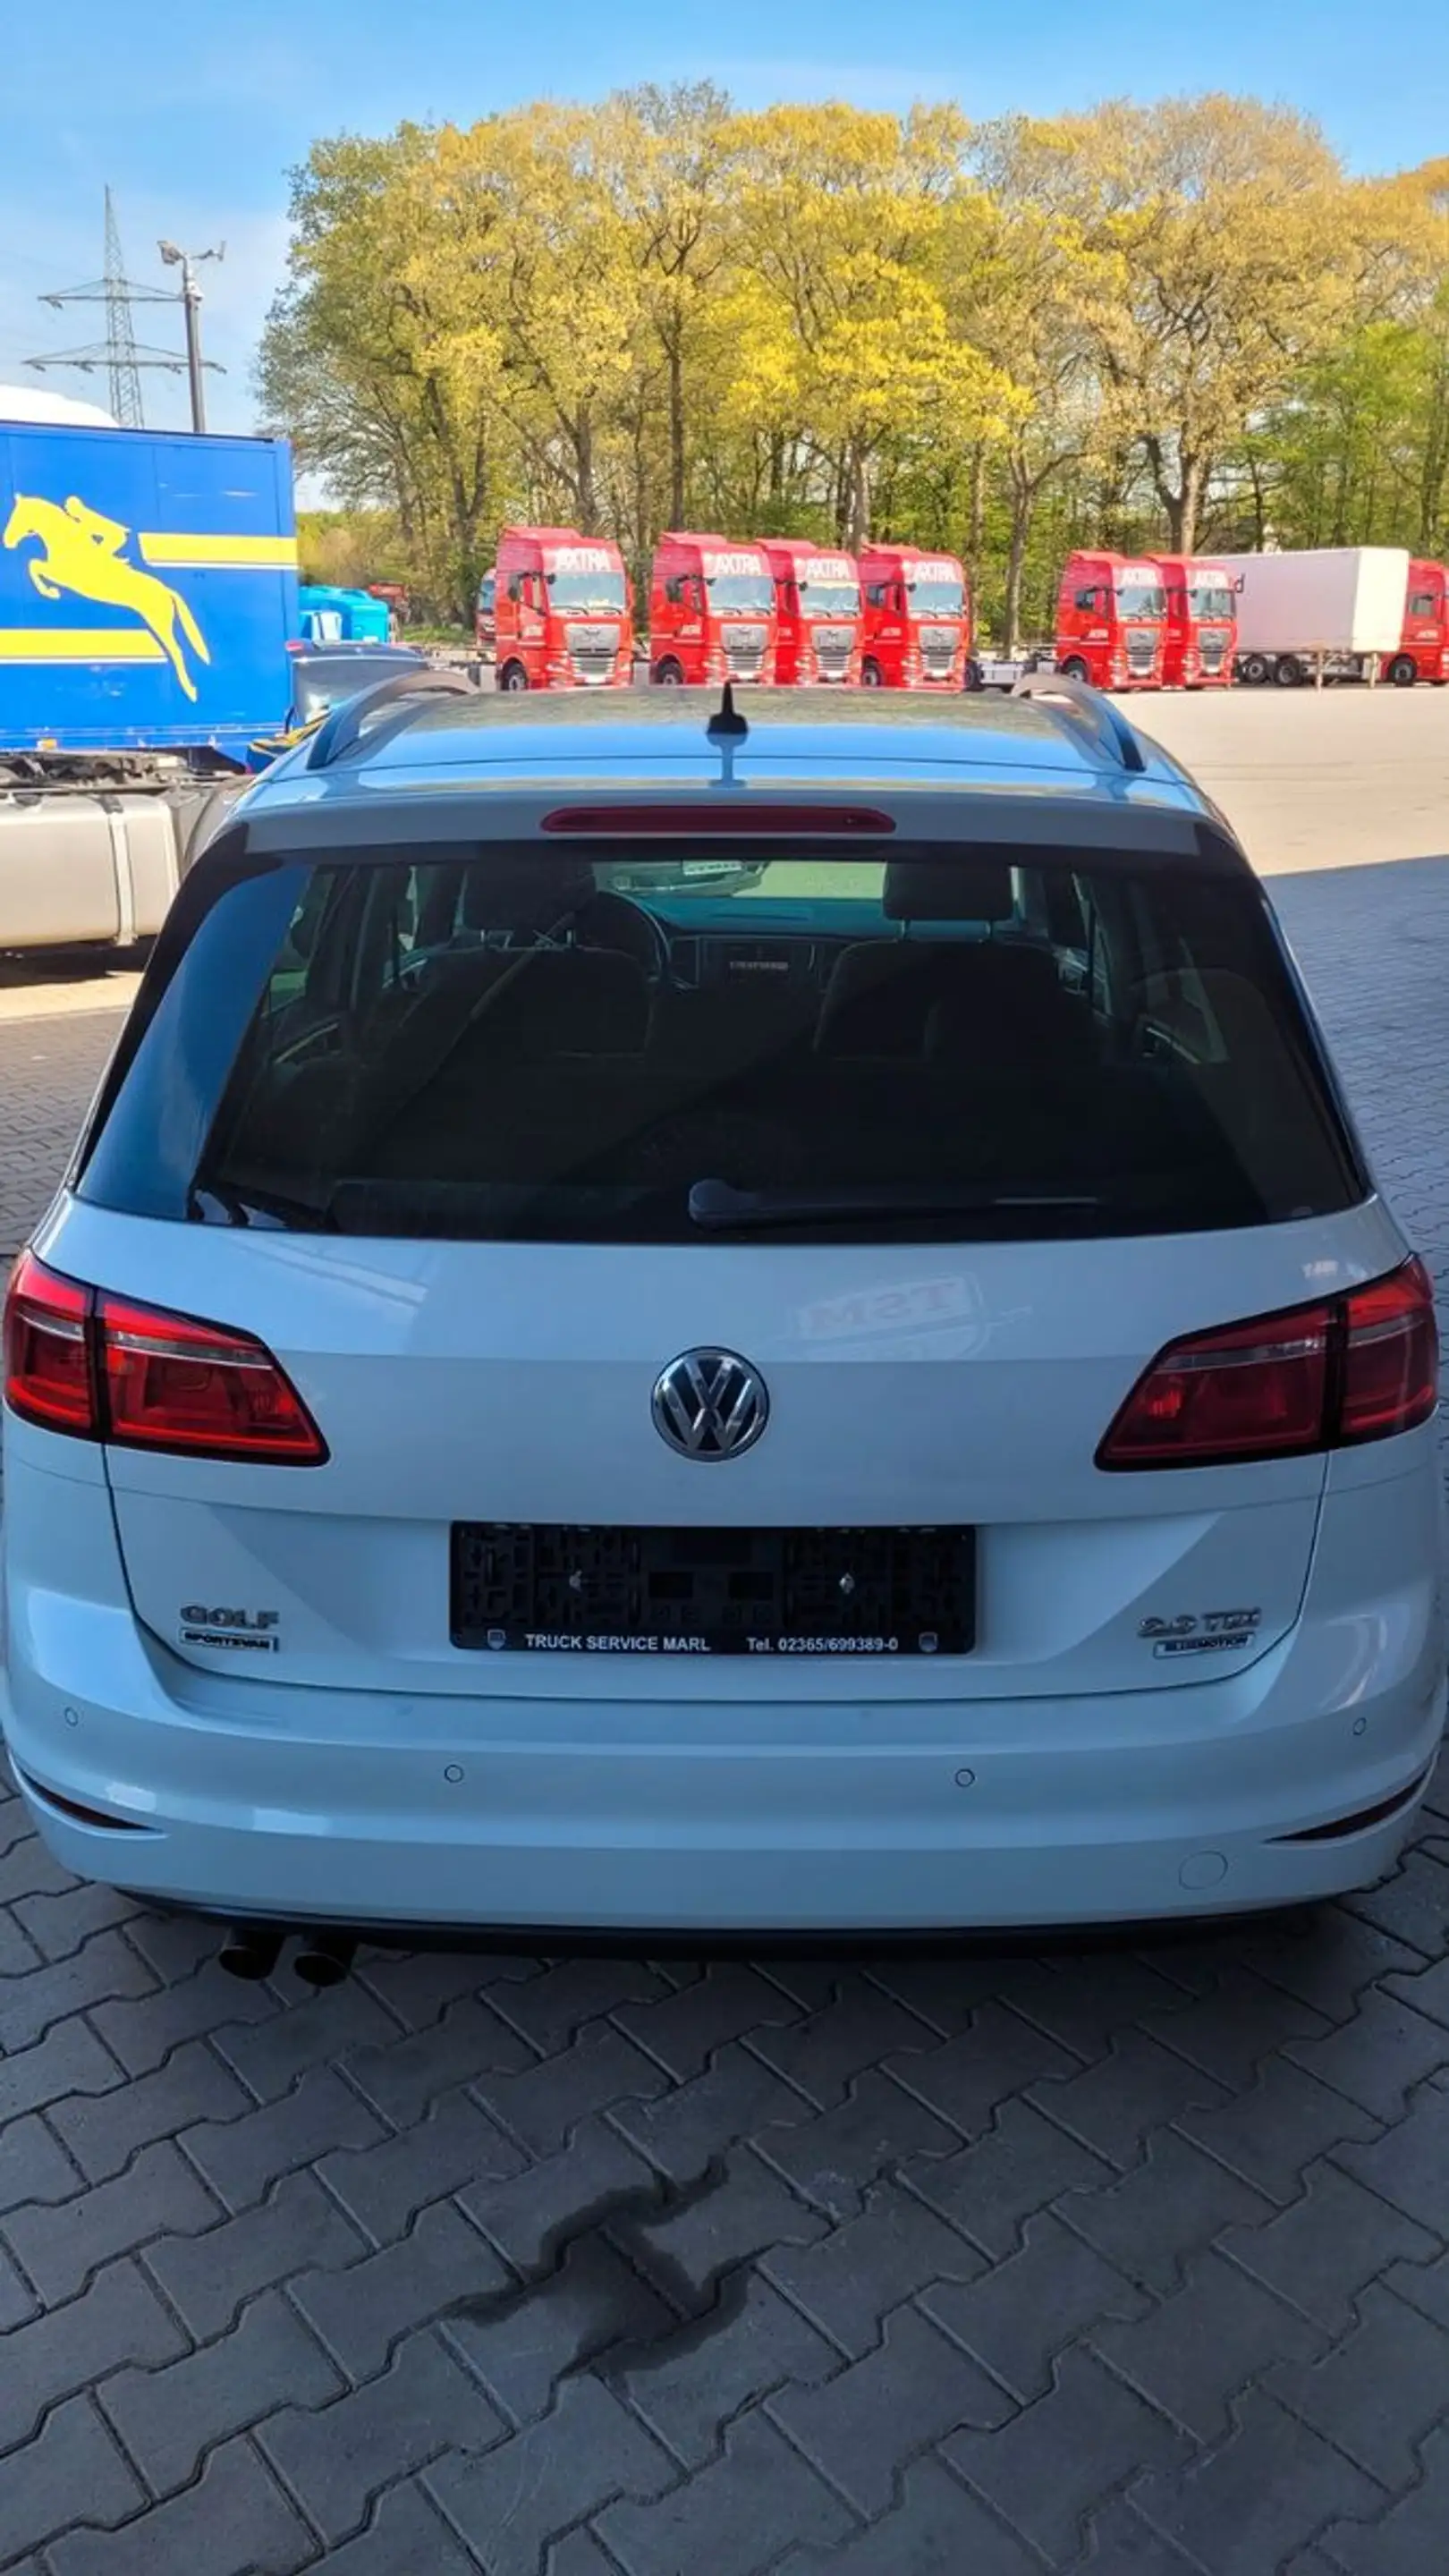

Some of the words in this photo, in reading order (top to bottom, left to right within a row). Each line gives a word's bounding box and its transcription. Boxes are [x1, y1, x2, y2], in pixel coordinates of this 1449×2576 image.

[180, 1606, 279, 1629] GOLF
[525, 1633, 582, 1649] TRUCK
[586, 1635, 658, 1650] SERVICE
[663, 1636, 711, 1652] MARL
[746, 1637, 775, 1652] Tel.
